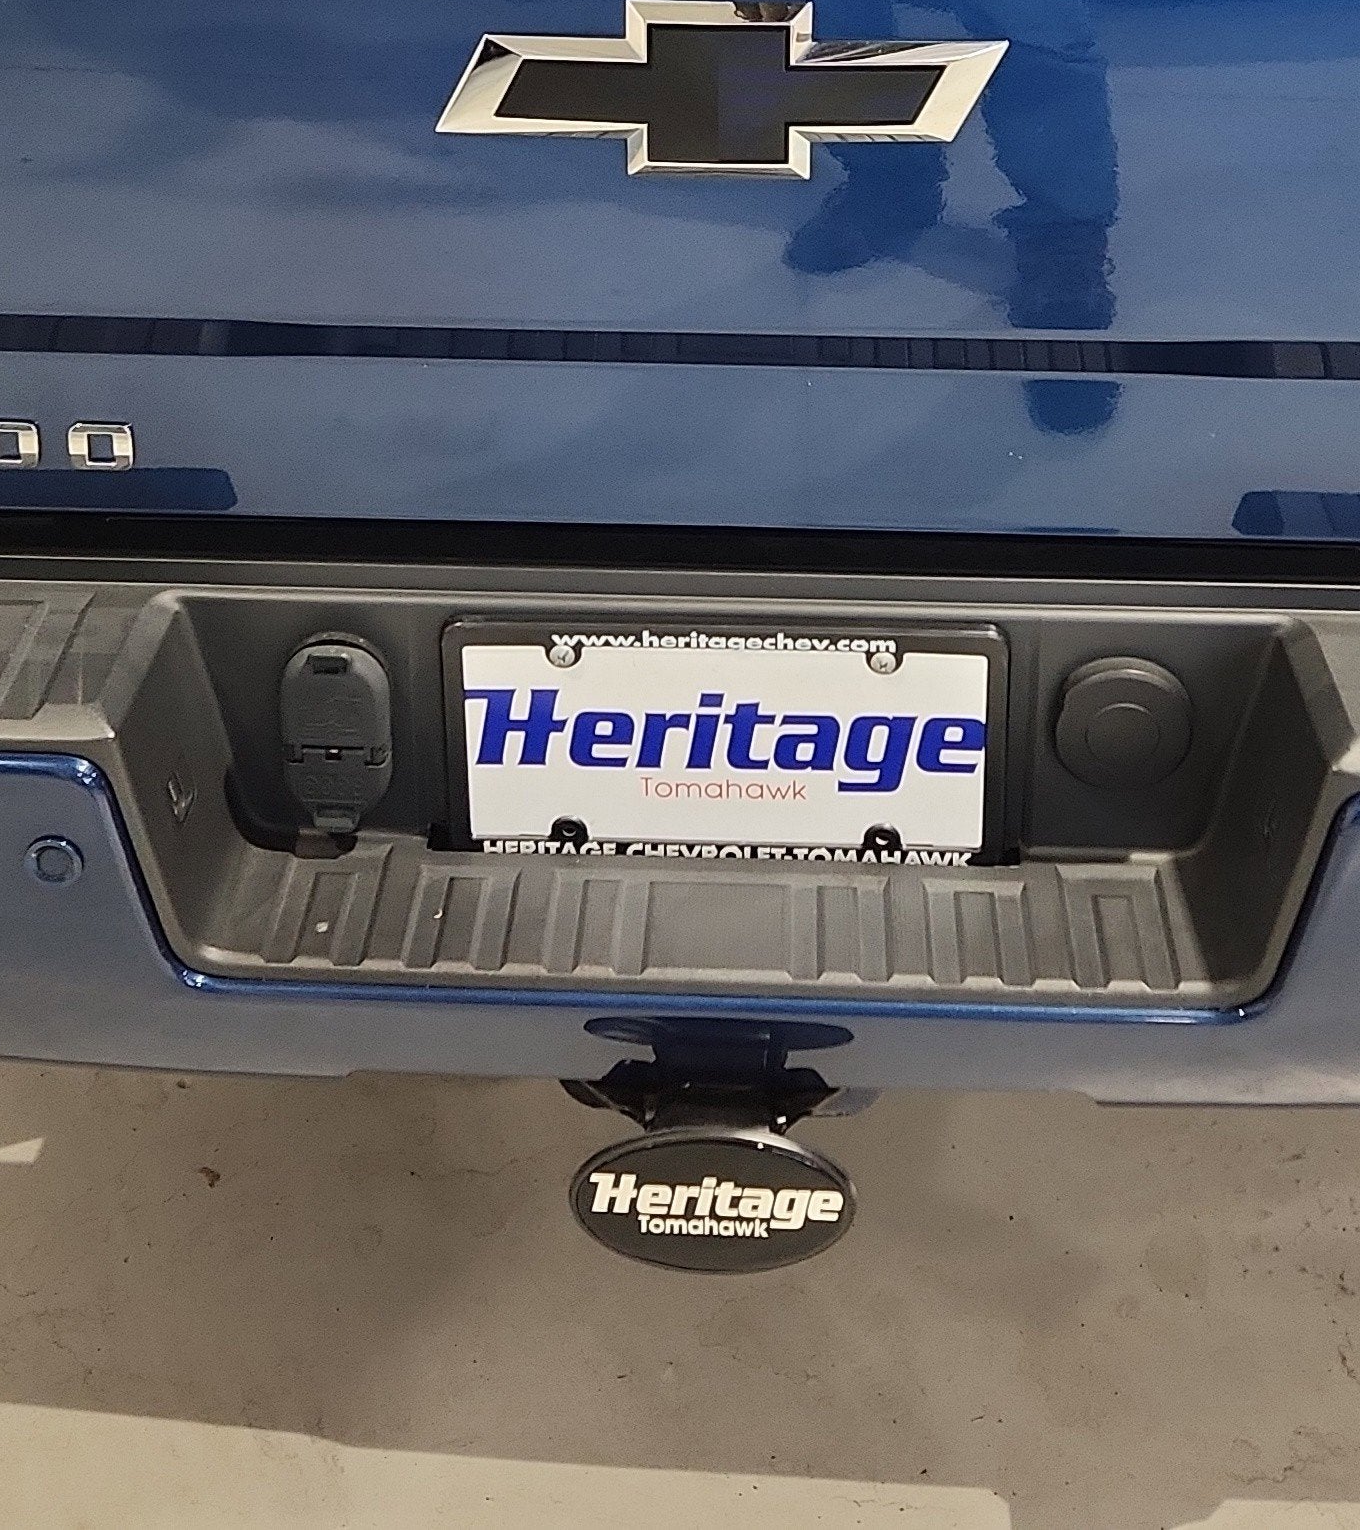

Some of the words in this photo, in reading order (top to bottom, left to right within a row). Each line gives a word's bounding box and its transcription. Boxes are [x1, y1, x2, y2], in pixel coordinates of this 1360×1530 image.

[551, 630, 897, 653] www.heritagechev.com
[463, 687, 988, 793] Heritage
[640, 775, 808, 802] Tomahawk
[589, 1172, 844, 1230] Heritage
[638, 1214, 770, 1239] Tomahawk
